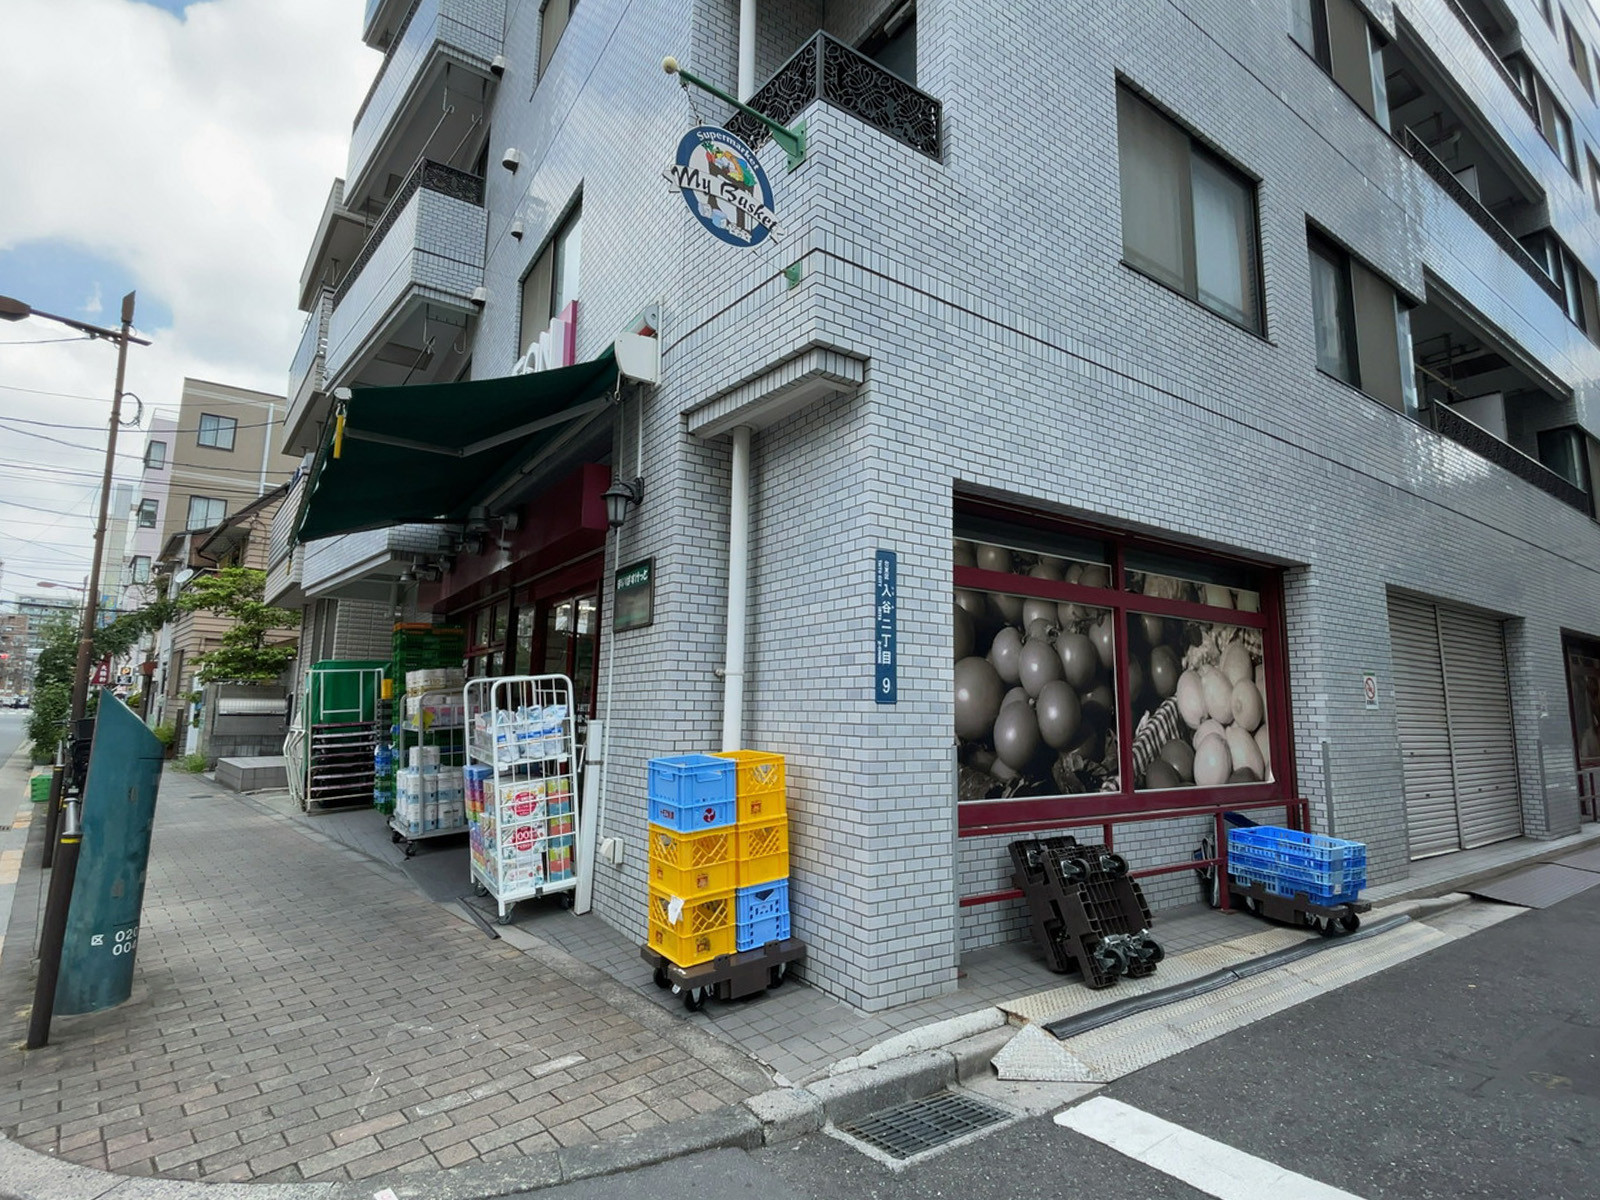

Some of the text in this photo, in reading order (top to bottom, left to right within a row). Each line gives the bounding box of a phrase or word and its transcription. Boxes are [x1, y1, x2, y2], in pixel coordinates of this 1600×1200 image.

[696, 130, 760, 170] Supermarket
[671, 165, 779, 232] My Basket
[881, 583, 892, 664] 入谷二丁目
[882, 677, 891, 694] 9
